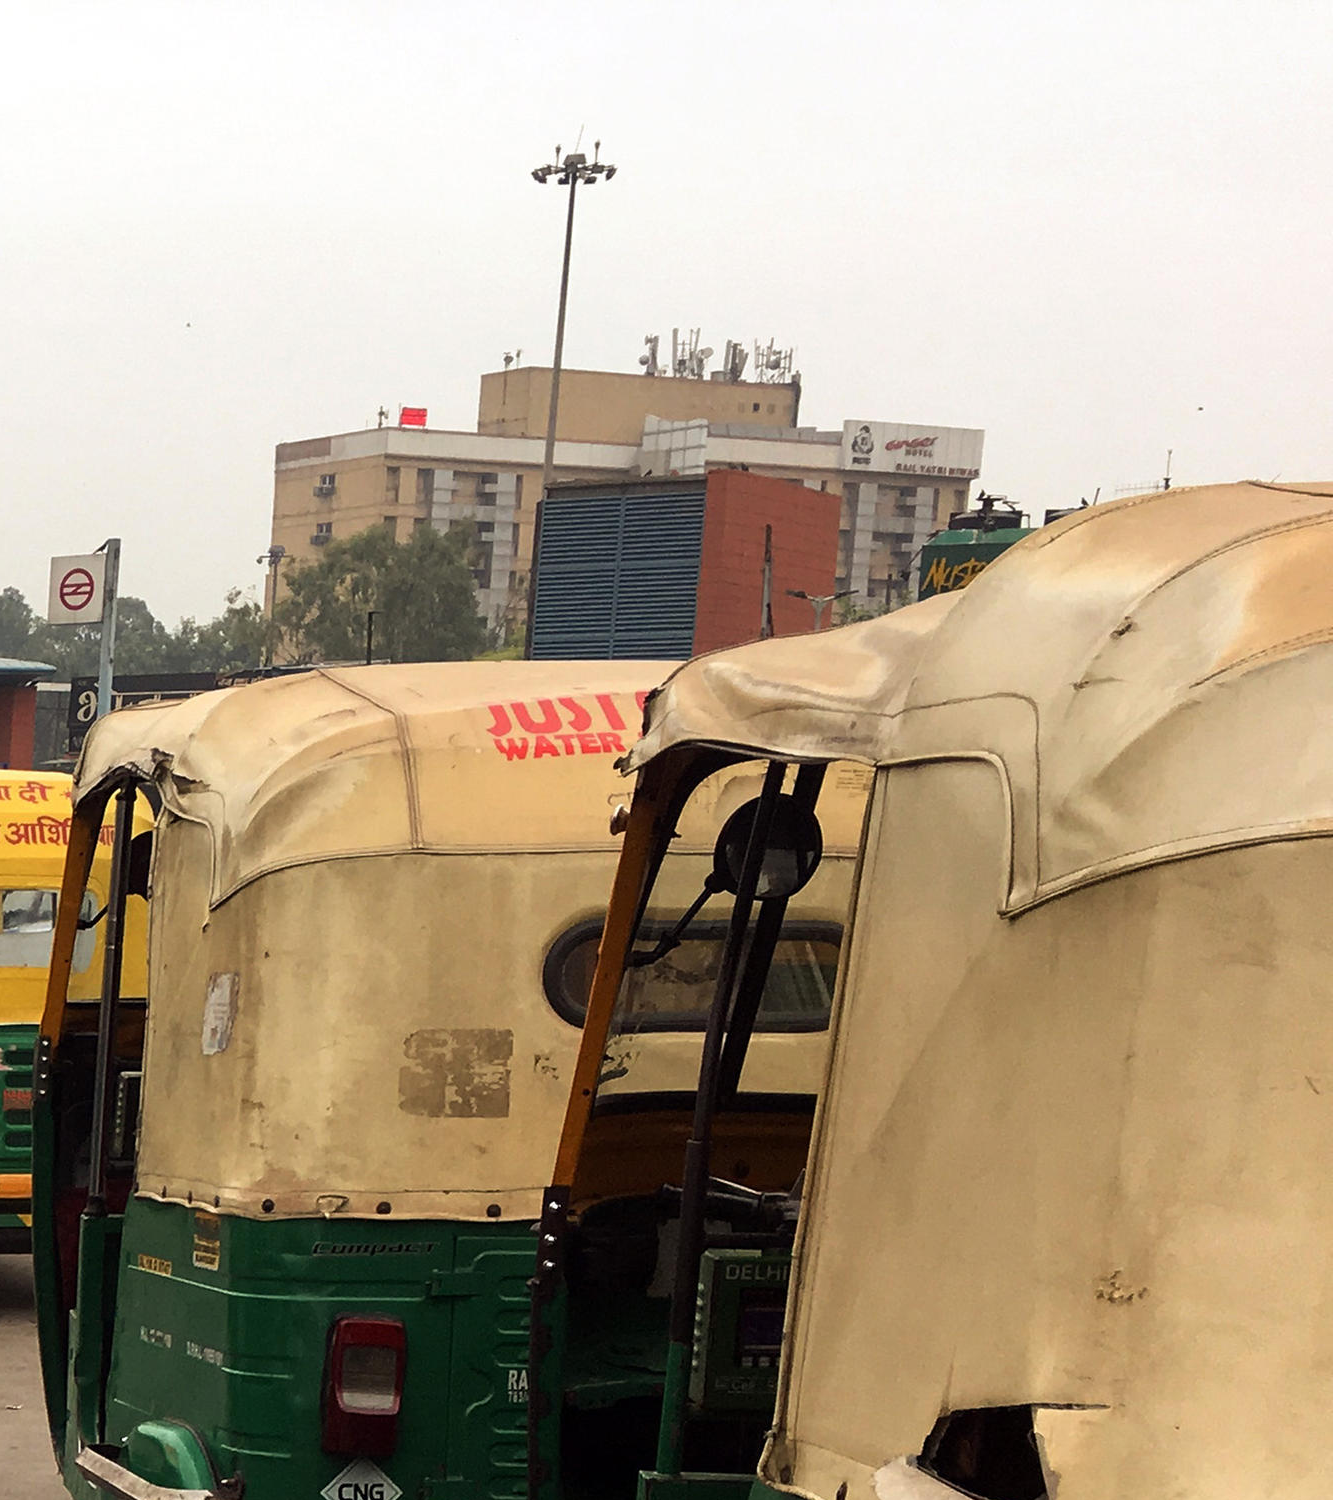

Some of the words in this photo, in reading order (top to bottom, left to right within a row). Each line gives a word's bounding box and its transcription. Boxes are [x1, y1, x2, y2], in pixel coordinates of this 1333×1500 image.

[895, 463, 918, 472] RAIL
[493, 732, 627, 761] WATER
[18, 781, 55, 804] दी
